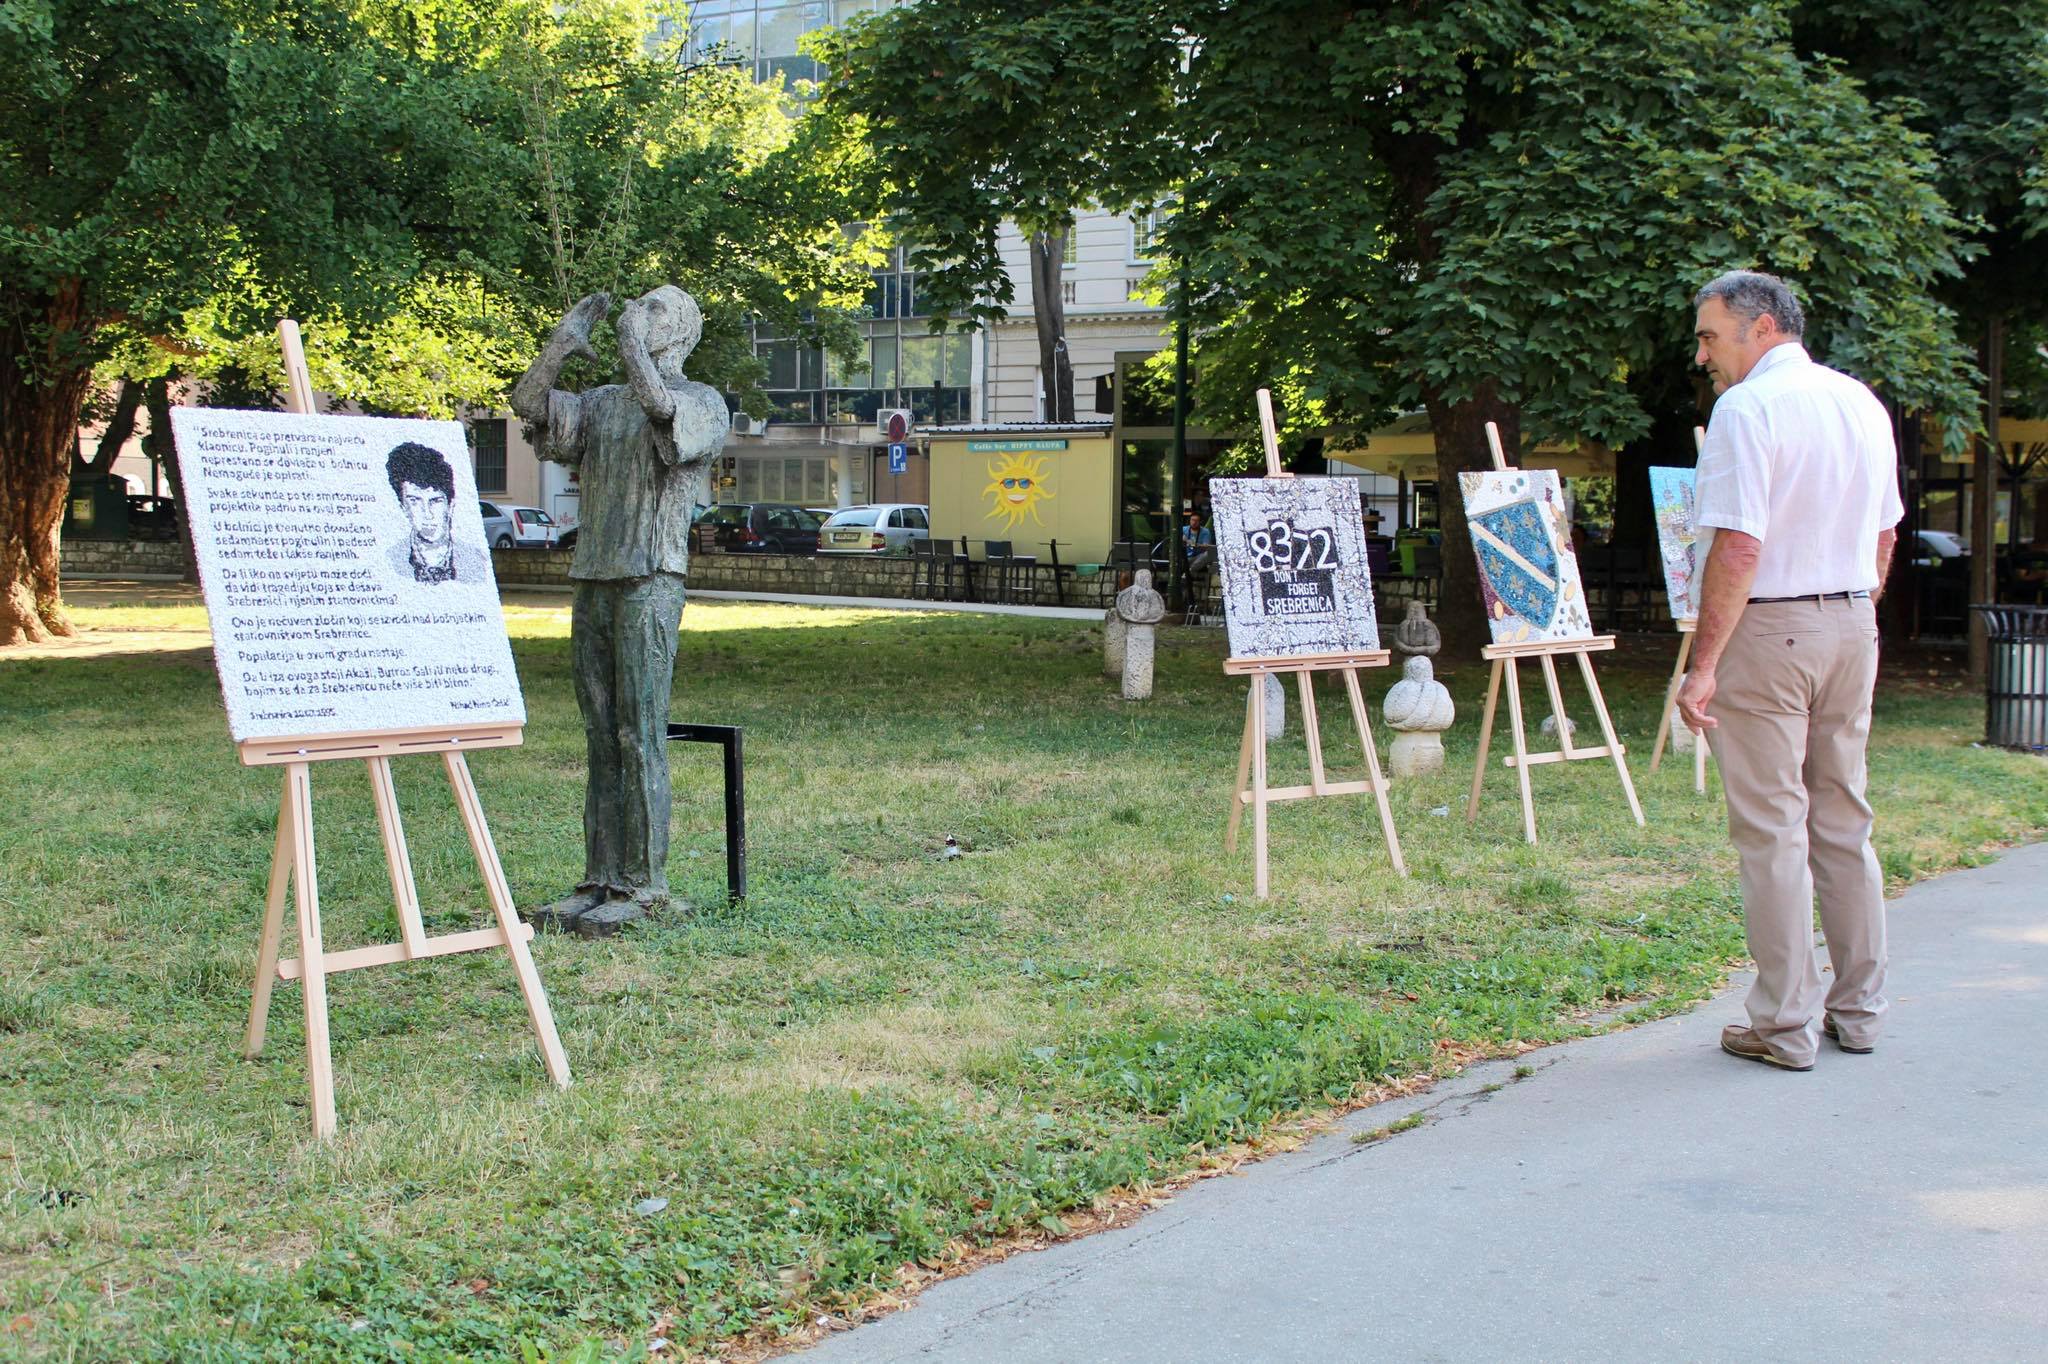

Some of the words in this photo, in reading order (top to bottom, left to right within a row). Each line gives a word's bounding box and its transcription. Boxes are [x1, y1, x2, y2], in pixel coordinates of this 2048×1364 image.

[250, 442, 294, 456] Poginuli
[300, 446, 336, 457] ranjeni
[201, 455, 262, 467] neprestano
[318, 460, 326, 469] u
[263, 468, 273, 482] je
[207, 487, 238, 499] Svake
[264, 502, 297, 515] padnu
[264, 522, 273, 535] je
[215, 534, 279, 547] sedamnaest
[337, 536, 377, 548] pedeset
[1251, 521, 1338, 572] 8372
[218, 550, 253, 560] sedam
[222, 568, 237, 579] Da
[239, 568, 247, 579] li
[249, 568, 266, 579] iko
[268, 571, 282, 579] na
[284, 569, 318, 581] svijetu
[320, 569, 348, 579] može
[1273, 570, 1298, 583] DON'T
[225, 583, 238, 593] da
[262, 582, 311, 595] tragediju
[1288, 582, 1319, 596] FORGET
[289, 596, 325, 608] njenim
[1266, 595, 1334, 615] SREBRENICA
[232, 616, 254, 628] Ovo
[255, 616, 267, 630] je
[347, 614, 366, 628] koji
[368, 617, 379, 625] se
[412, 614, 431, 624] nad
[238, 650, 295, 663] Populacija
[296, 652, 304, 660] u
[307, 651, 335, 660] ovom
[336, 648, 366, 662] gradu
[242, 672, 258, 682] Da
[269, 673, 286, 682] iza
[287, 672, 320, 684] ovoga
[321, 669, 344, 682] stoji
[244, 686, 276, 698] bojim
[279, 687, 291, 696] se
[293, 685, 306, 695] da
[307, 686, 320, 694] za
[321, 682, 377, 693] Srebrenicu
